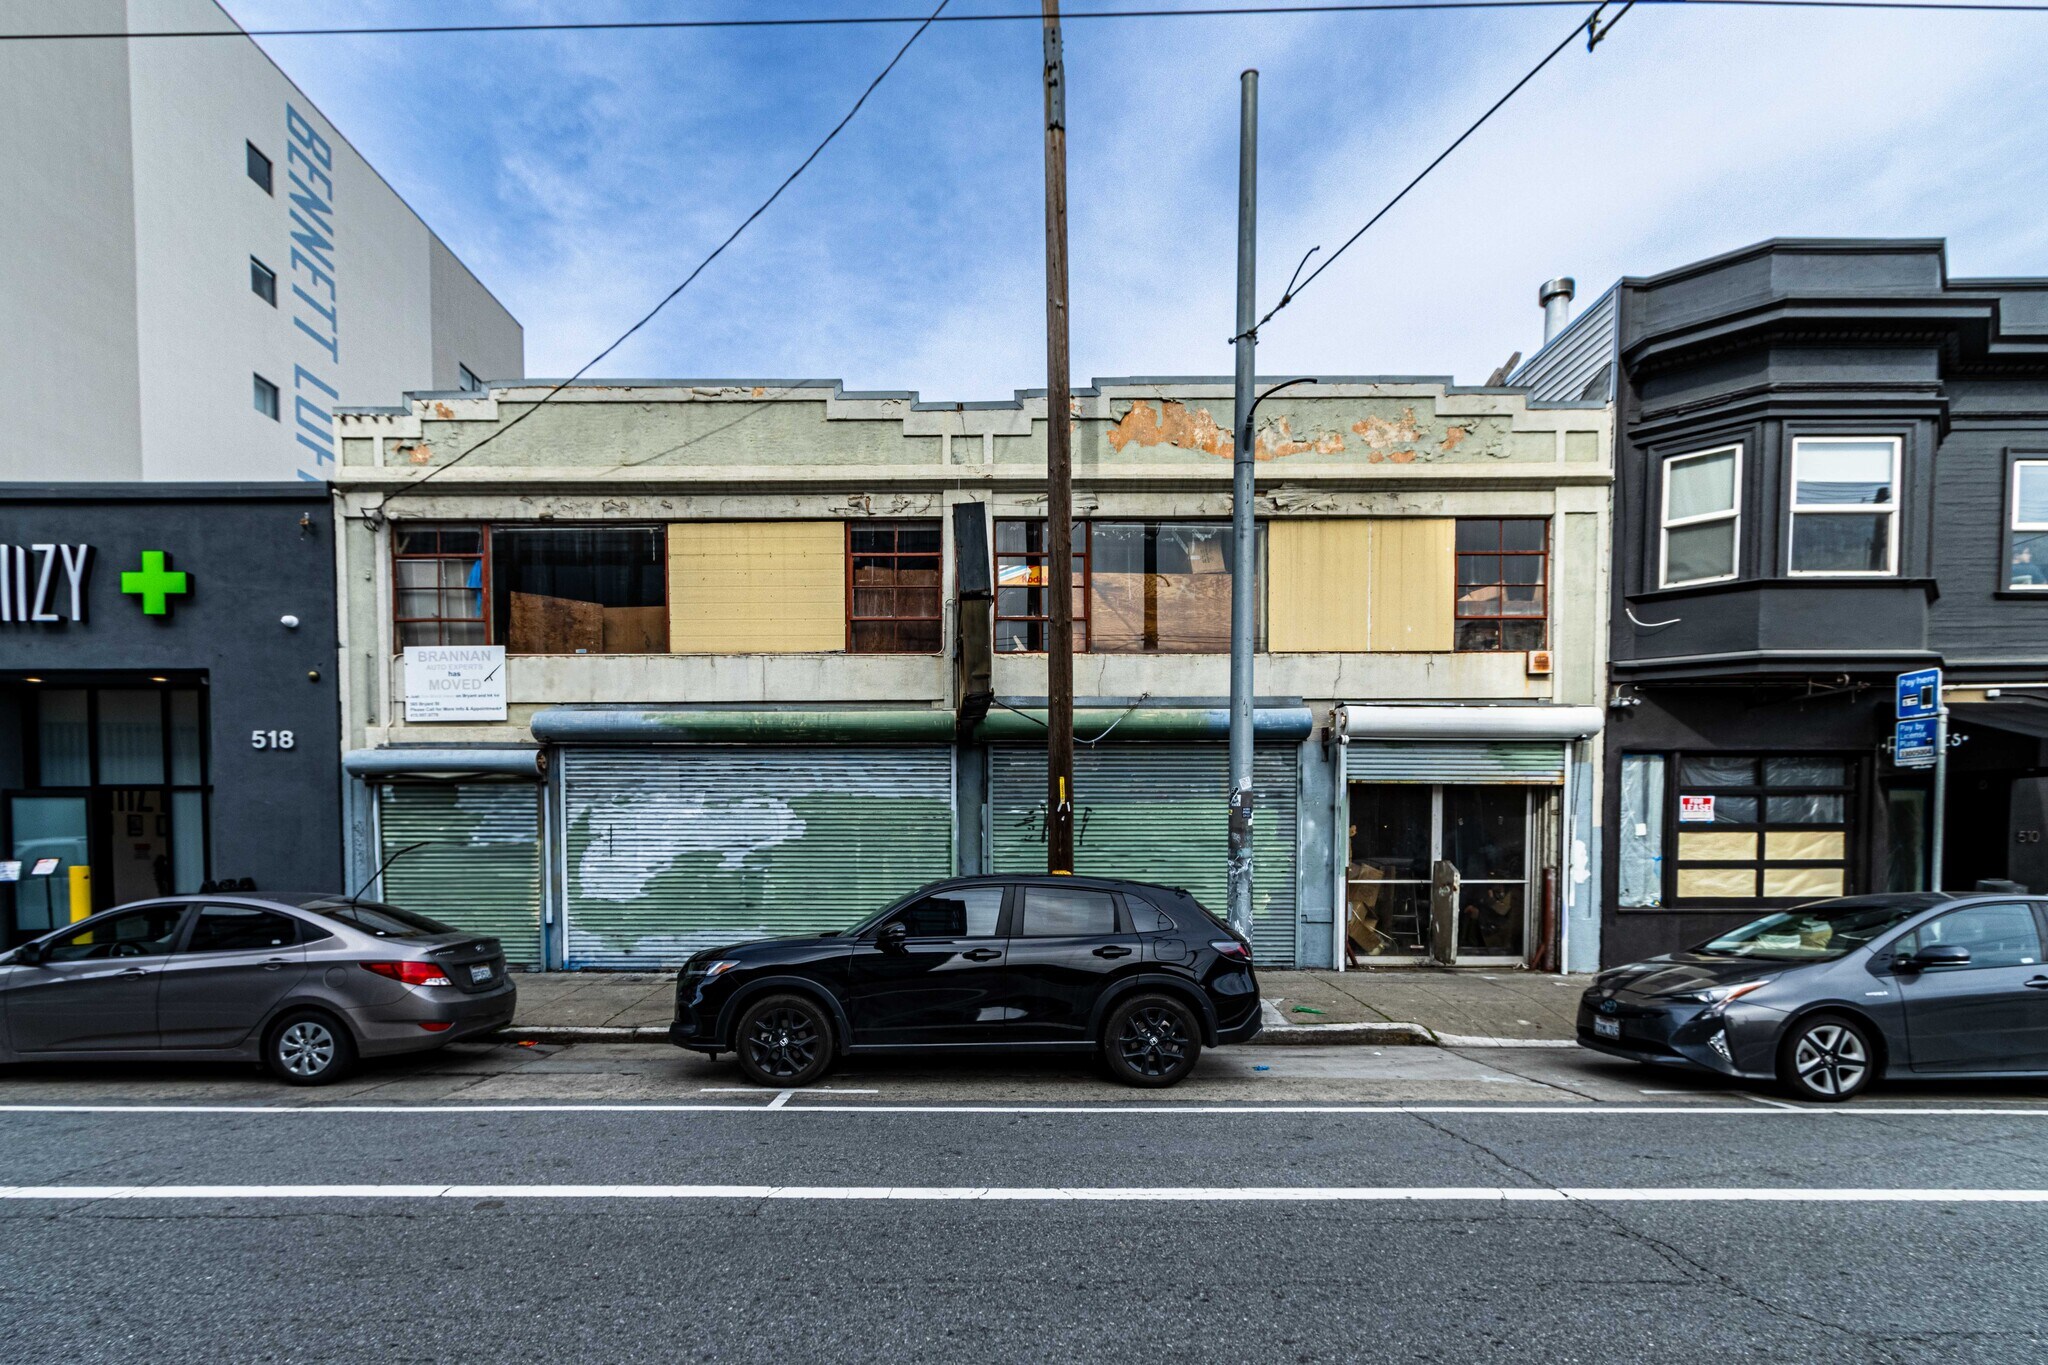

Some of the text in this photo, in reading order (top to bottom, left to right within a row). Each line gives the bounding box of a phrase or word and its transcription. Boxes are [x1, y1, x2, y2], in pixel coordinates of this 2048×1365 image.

[286, 101, 338, 364] BENNETT
[1021, 575, 1048, 583] Kodk
[418, 650, 491, 662] BRANNAN
[429, 679, 481, 690] MOVED
[1900, 675, 1936, 687] Pay here
[1900, 723, 1925, 732] Pay by
[251, 730, 294, 748] 518
[2018, 830, 2040, 842] 510
